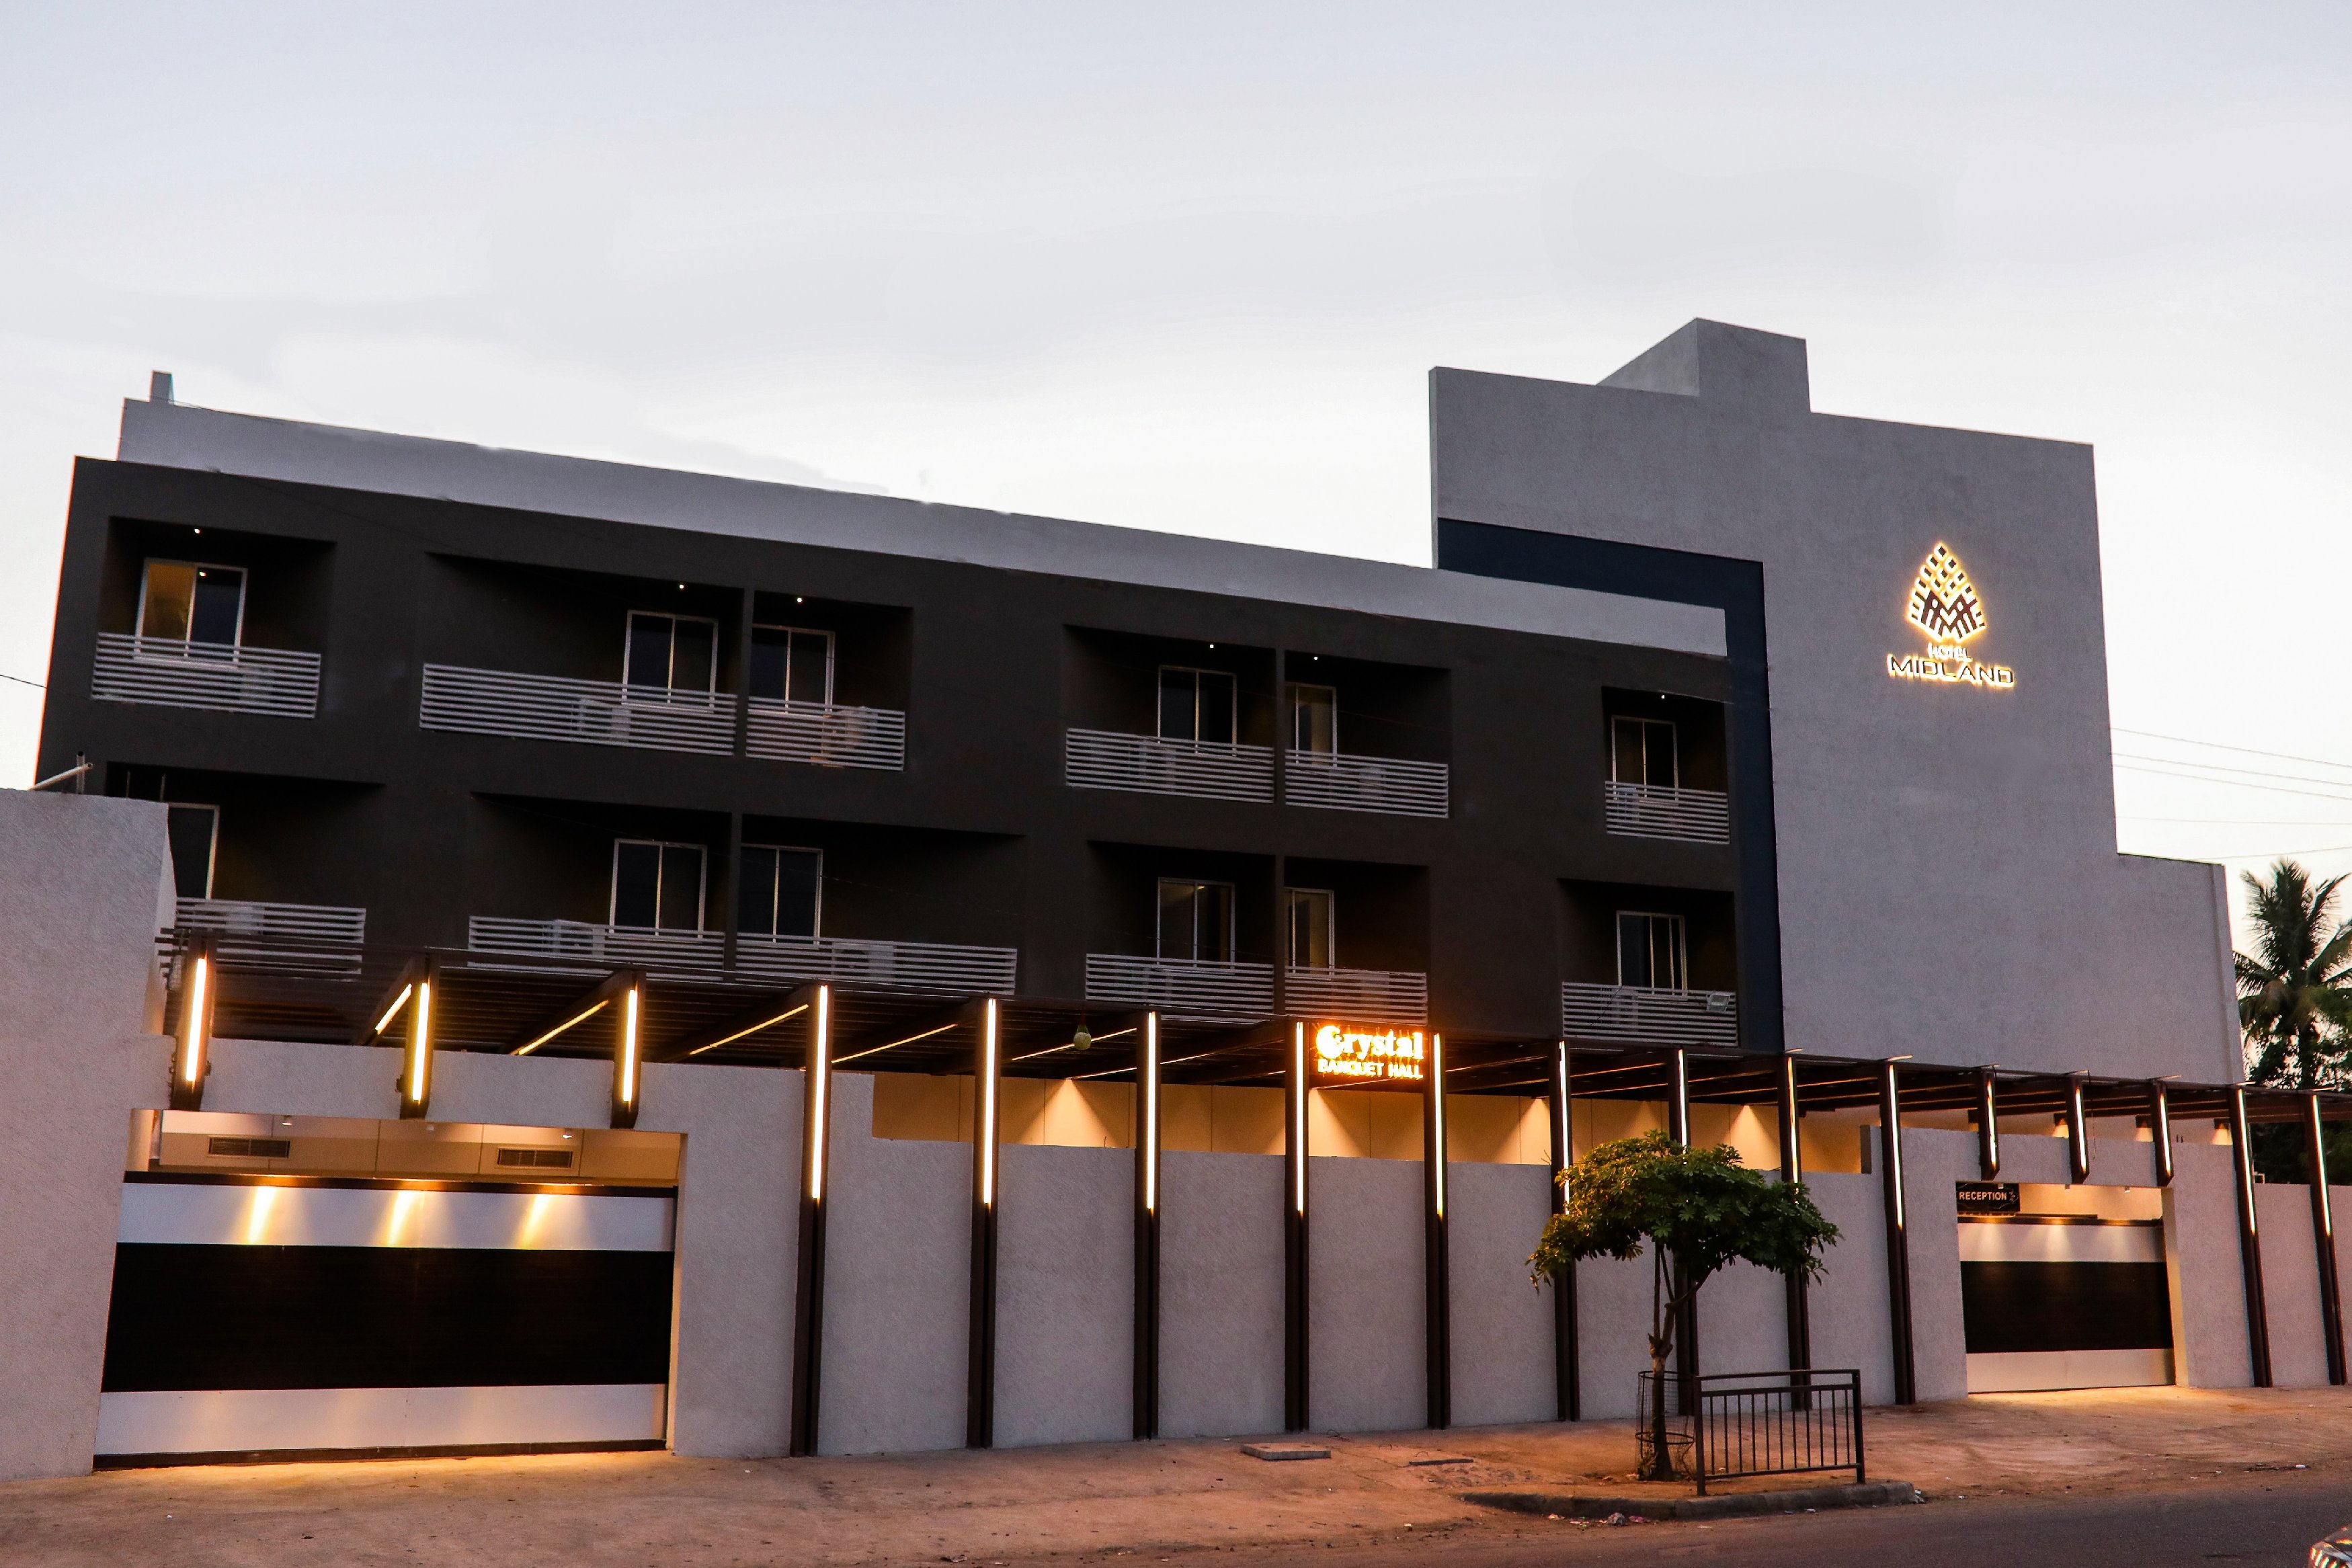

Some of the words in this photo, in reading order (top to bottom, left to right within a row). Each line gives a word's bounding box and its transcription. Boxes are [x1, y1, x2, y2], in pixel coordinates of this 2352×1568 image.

[1928, 643, 1972, 662] HOTEL
[1887, 654, 2015, 688] MIDLAND
[1316, 1025, 1424, 1060] Crystal
[1318, 1059, 1385, 1076] BANQUET
[1388, 1064, 1424, 1079] HALL
[1959, 1192, 2006, 1200] RECEPTION
